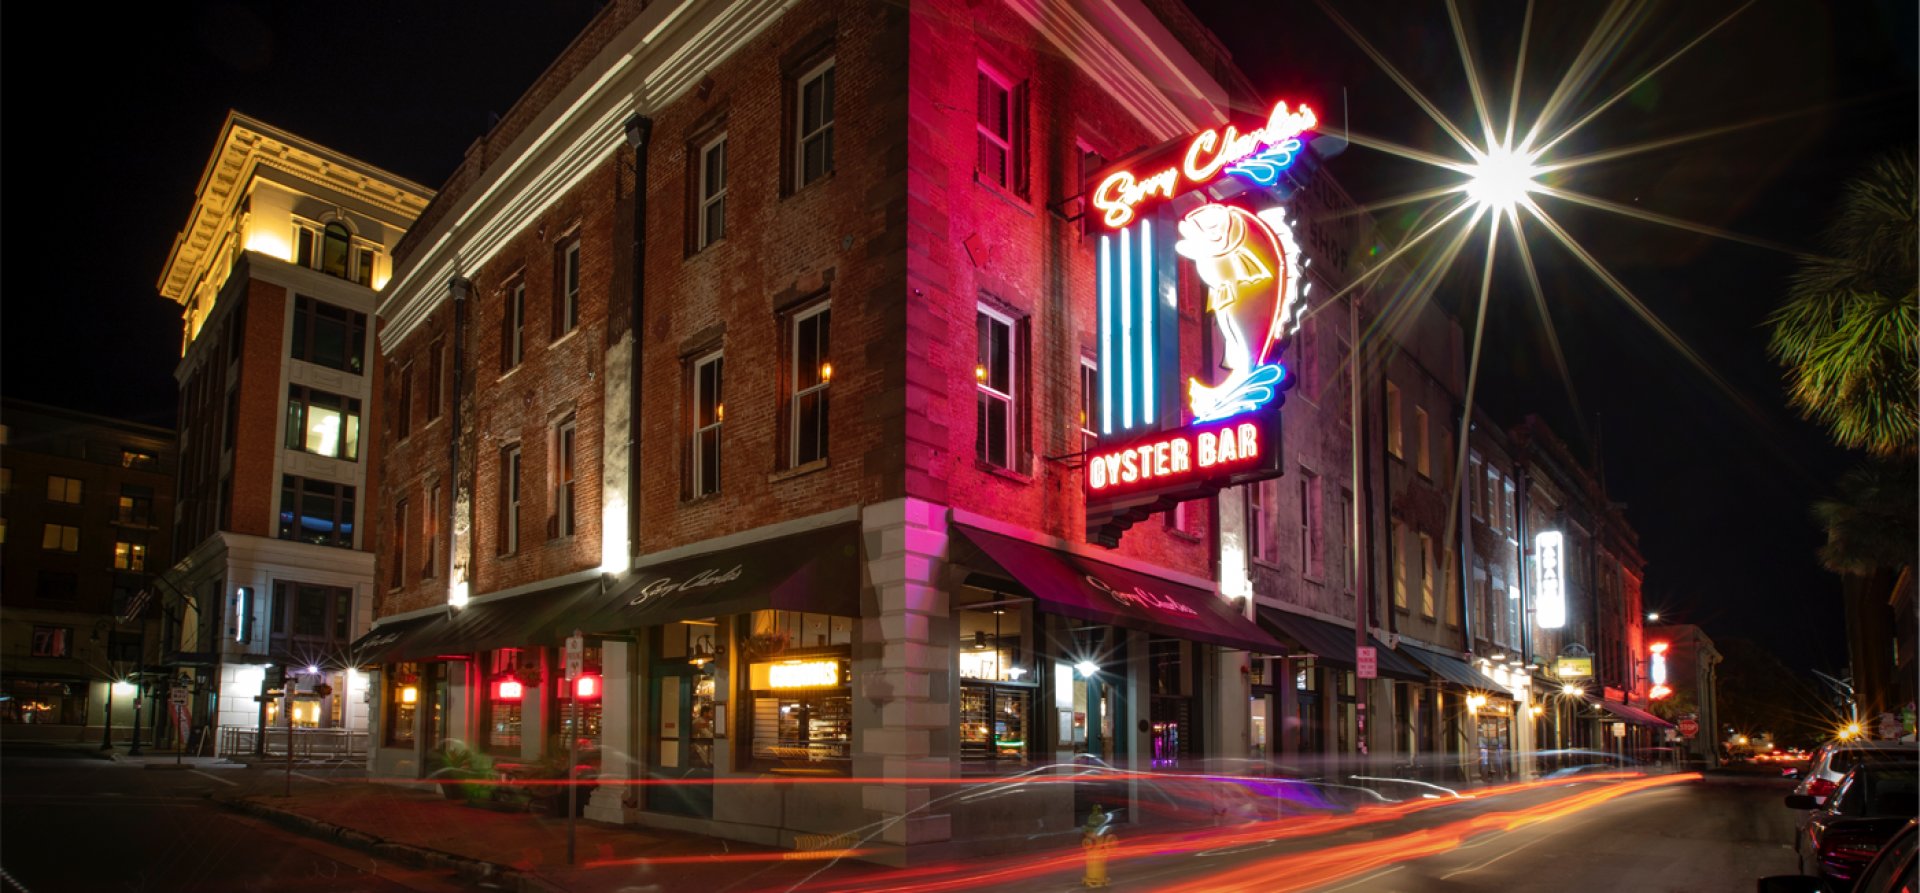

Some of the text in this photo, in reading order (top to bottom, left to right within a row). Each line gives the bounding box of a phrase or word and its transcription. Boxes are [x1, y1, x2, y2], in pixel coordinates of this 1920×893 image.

[1093, 99, 1319, 229] Sorry Charlie's
[1089, 422, 1258, 490] OYSTER BAR
